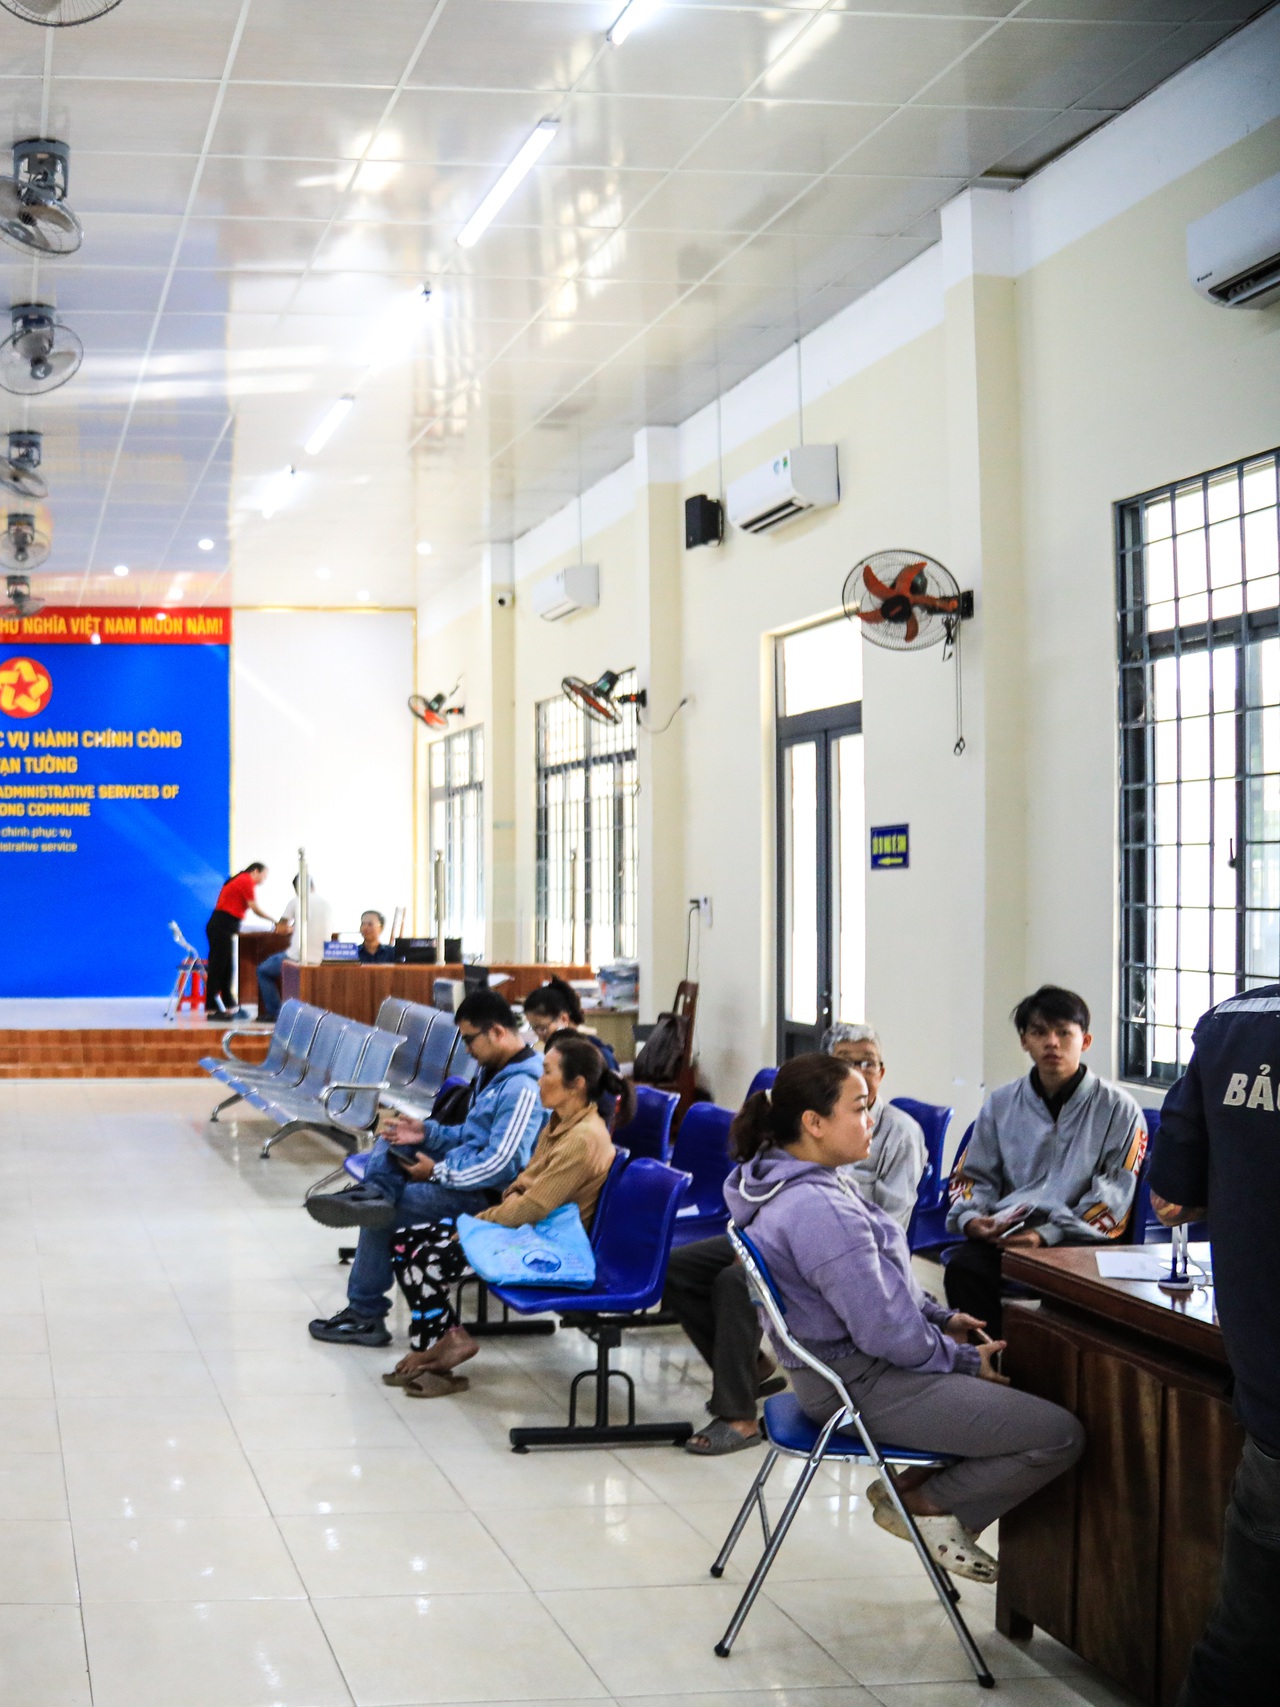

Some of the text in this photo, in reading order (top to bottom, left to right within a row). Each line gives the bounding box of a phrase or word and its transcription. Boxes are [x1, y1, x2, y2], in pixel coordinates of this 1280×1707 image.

[23, 615, 67, 634] NGHĨA
[70, 613, 101, 637] VIỆT
[105, 617, 137, 634] NAM
[186, 614, 223, 634] NĂM!
[7, 730, 30, 751] VỤ
[33, 728, 79, 748] HÀNH
[82, 728, 133, 748] CHÍNH
[137, 728, 182, 748] CÔNG
[24, 754, 78, 774] TƯỜNG
[98, 785, 159, 799] SERVICES
[162, 785, 179, 799] OF
[27, 803, 91, 817] COMMUNE
[1222, 1063, 1280, 1112] BẢ
